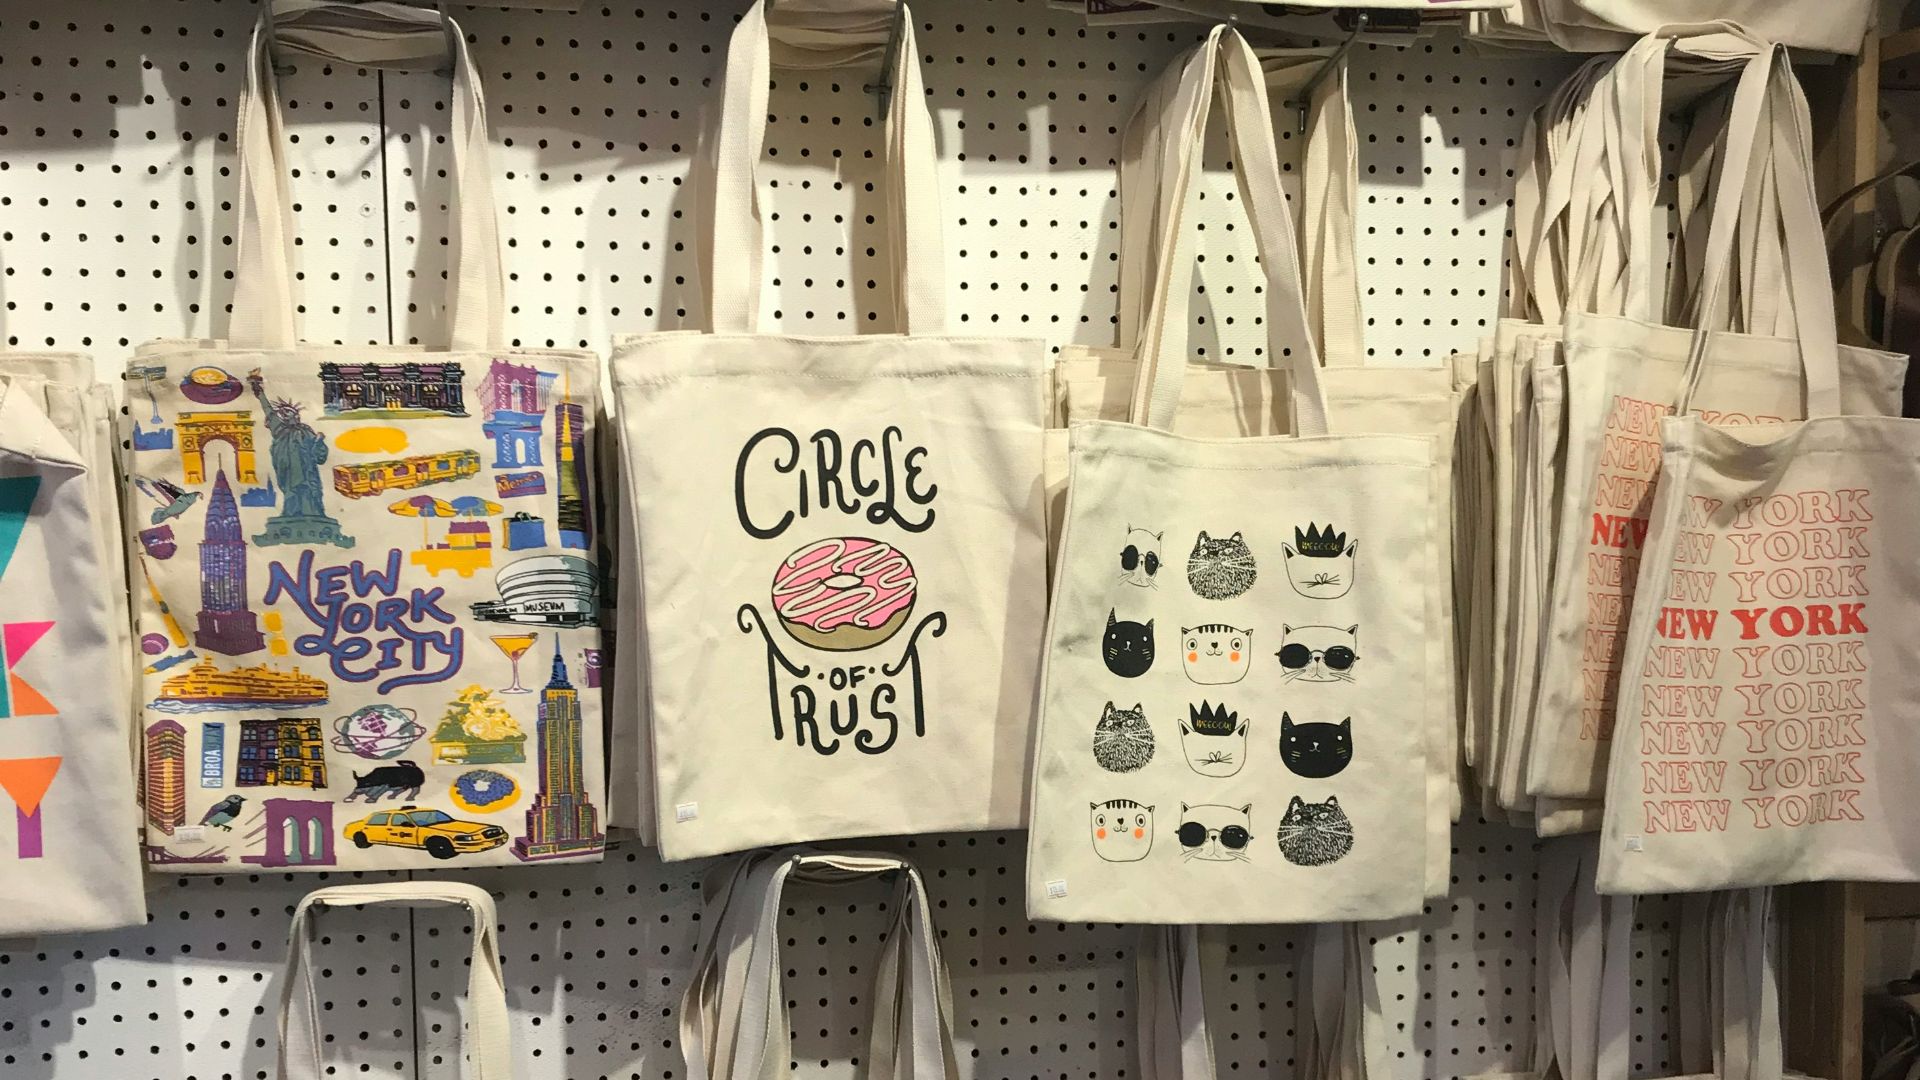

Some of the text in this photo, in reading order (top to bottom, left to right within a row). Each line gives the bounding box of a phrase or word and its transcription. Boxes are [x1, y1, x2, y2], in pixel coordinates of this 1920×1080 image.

[734, 426, 938, 540] CIRCLE
[1732, 489, 1873, 529] YORK
[1728, 526, 1870, 565] YORK
[263, 548, 402, 626] NEW
[1667, 565, 1869, 603] EW YORK
[325, 587, 456, 645] YORK
[525, 602, 566, 613] MUSEUM
[1731, 602, 1869, 640] YORK
[296, 626, 464, 695] CITY
[1583, 629, 1629, 663] NE
[1643, 640, 1867, 679] NEW YORK
[1582, 669, 1622, 701] NE
[1641, 678, 1867, 717] NEW YORK
[1640, 714, 1866, 755] NEW YORK
[1641, 752, 1865, 794] NEW YORK
[1644, 789, 1865, 833] NEW YORK
